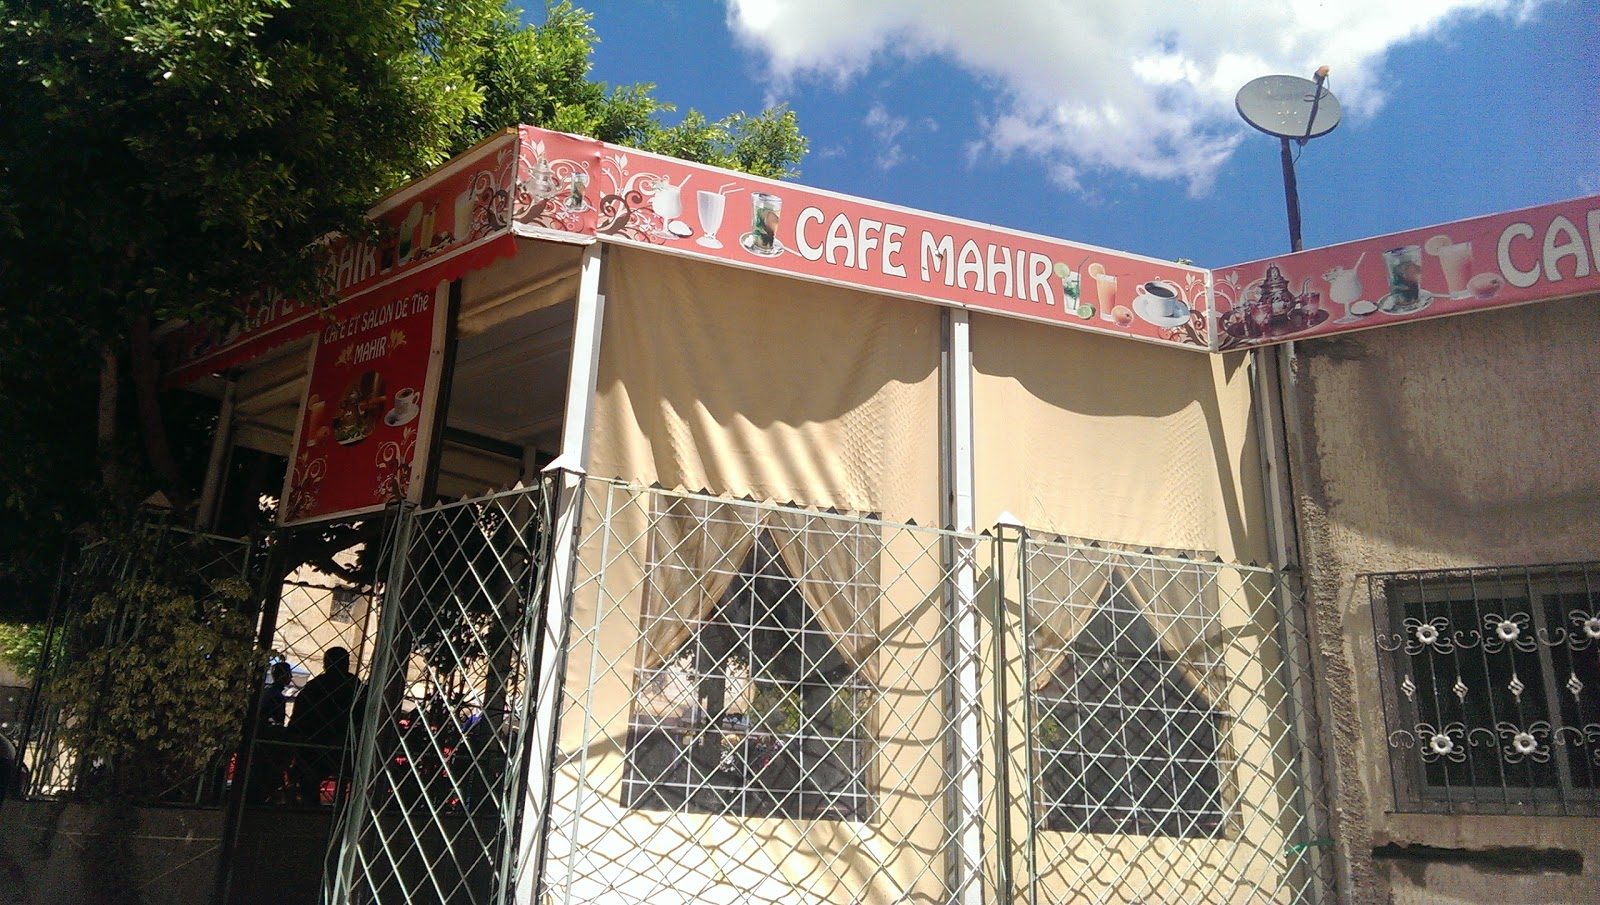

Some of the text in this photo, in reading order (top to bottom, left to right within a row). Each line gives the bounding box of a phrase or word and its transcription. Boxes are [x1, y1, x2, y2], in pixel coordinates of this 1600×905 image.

[795, 206, 1056, 306] CAFE MAHIR
[347, 314, 361, 337] ET
[361, 303, 394, 332] SALON
[395, 297, 409, 321] DE
[353, 336, 387, 365] MAHIR
